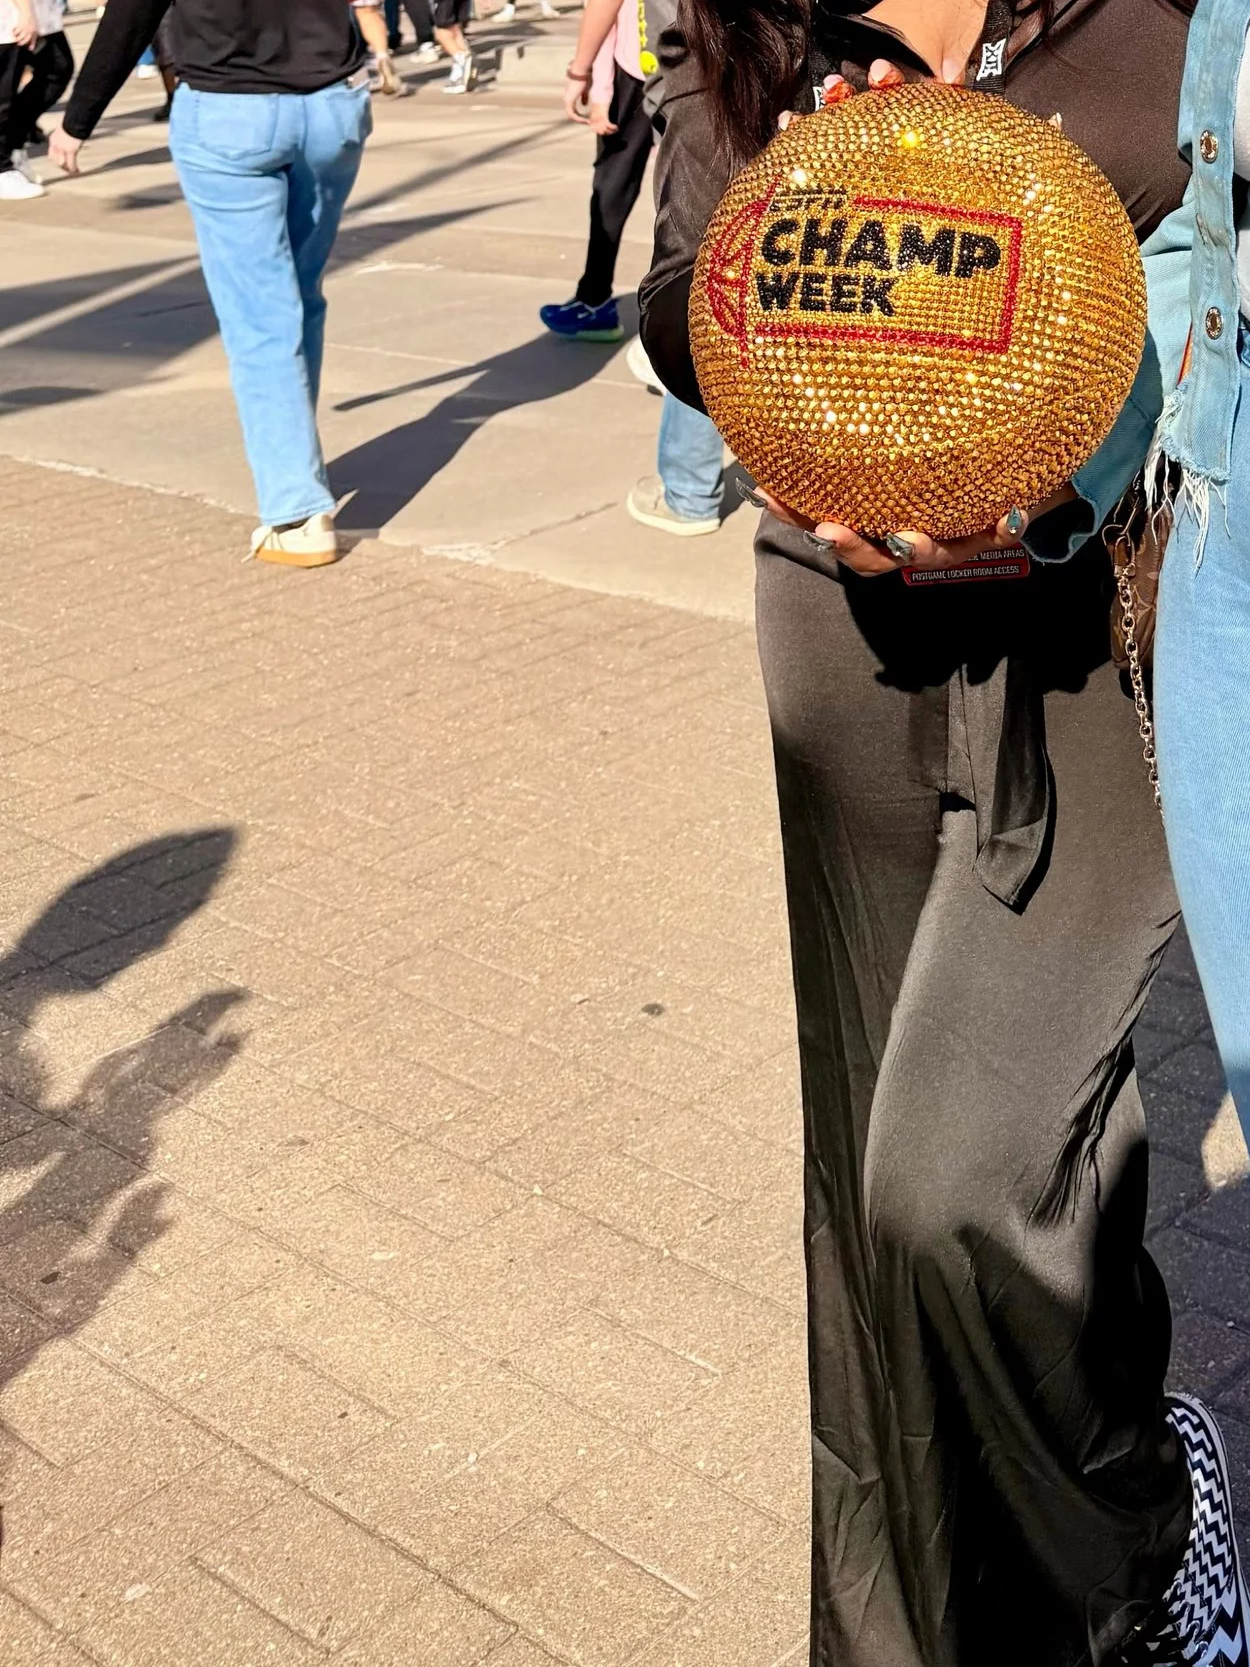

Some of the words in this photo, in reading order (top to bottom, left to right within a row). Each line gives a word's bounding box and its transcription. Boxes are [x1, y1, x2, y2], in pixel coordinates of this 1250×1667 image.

[761, 217, 1001, 279] CHAMP
[756, 271, 896, 316] WEEK
[1003, 548, 1025, 559] AREAS
[912, 569, 946, 581] POSTGAME
[947, 568, 972, 579] LOCKER
[972, 567, 993, 578] ROOM
[994, 565, 1019, 576] ACCESS
